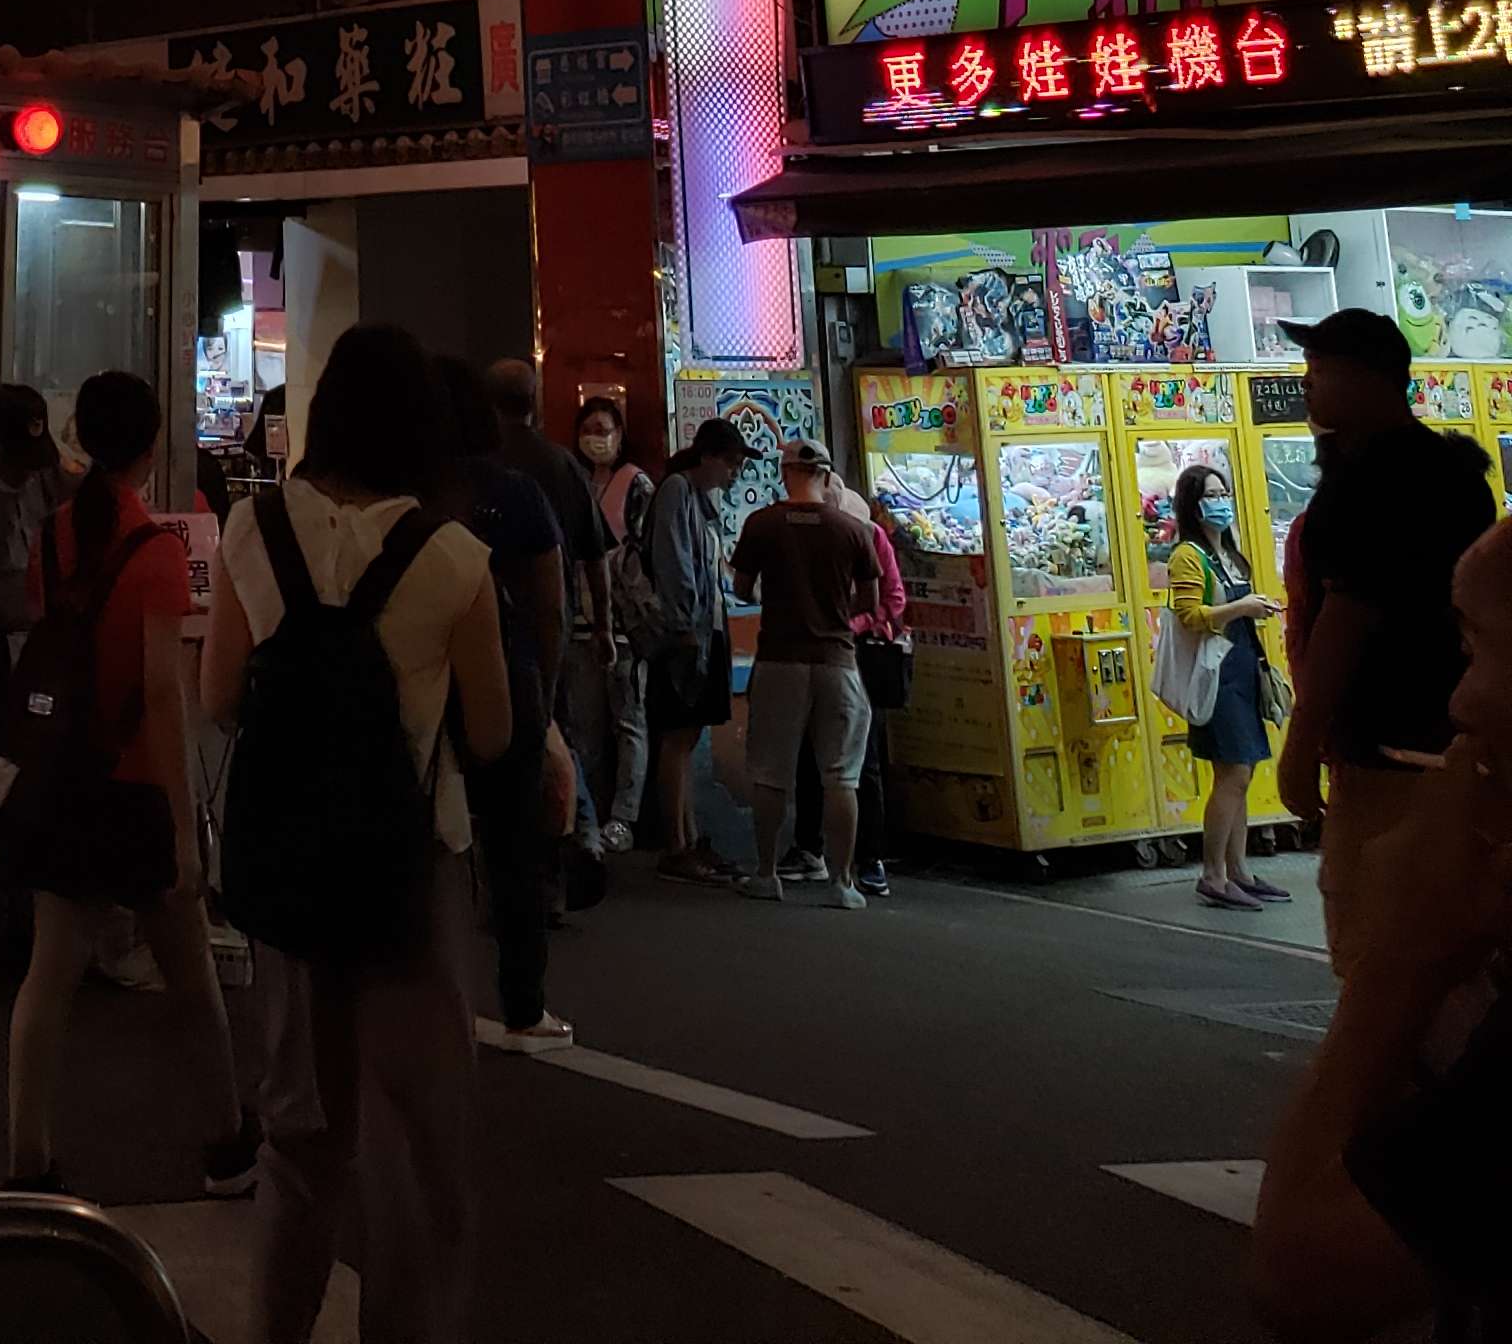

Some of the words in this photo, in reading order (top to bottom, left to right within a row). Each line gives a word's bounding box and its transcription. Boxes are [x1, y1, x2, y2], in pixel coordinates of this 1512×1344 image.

[881, 18, 1286, 108] 更多娃娃機台
[871, 396, 922, 430] HAPPY
[920, 403, 957, 430] ZOO
